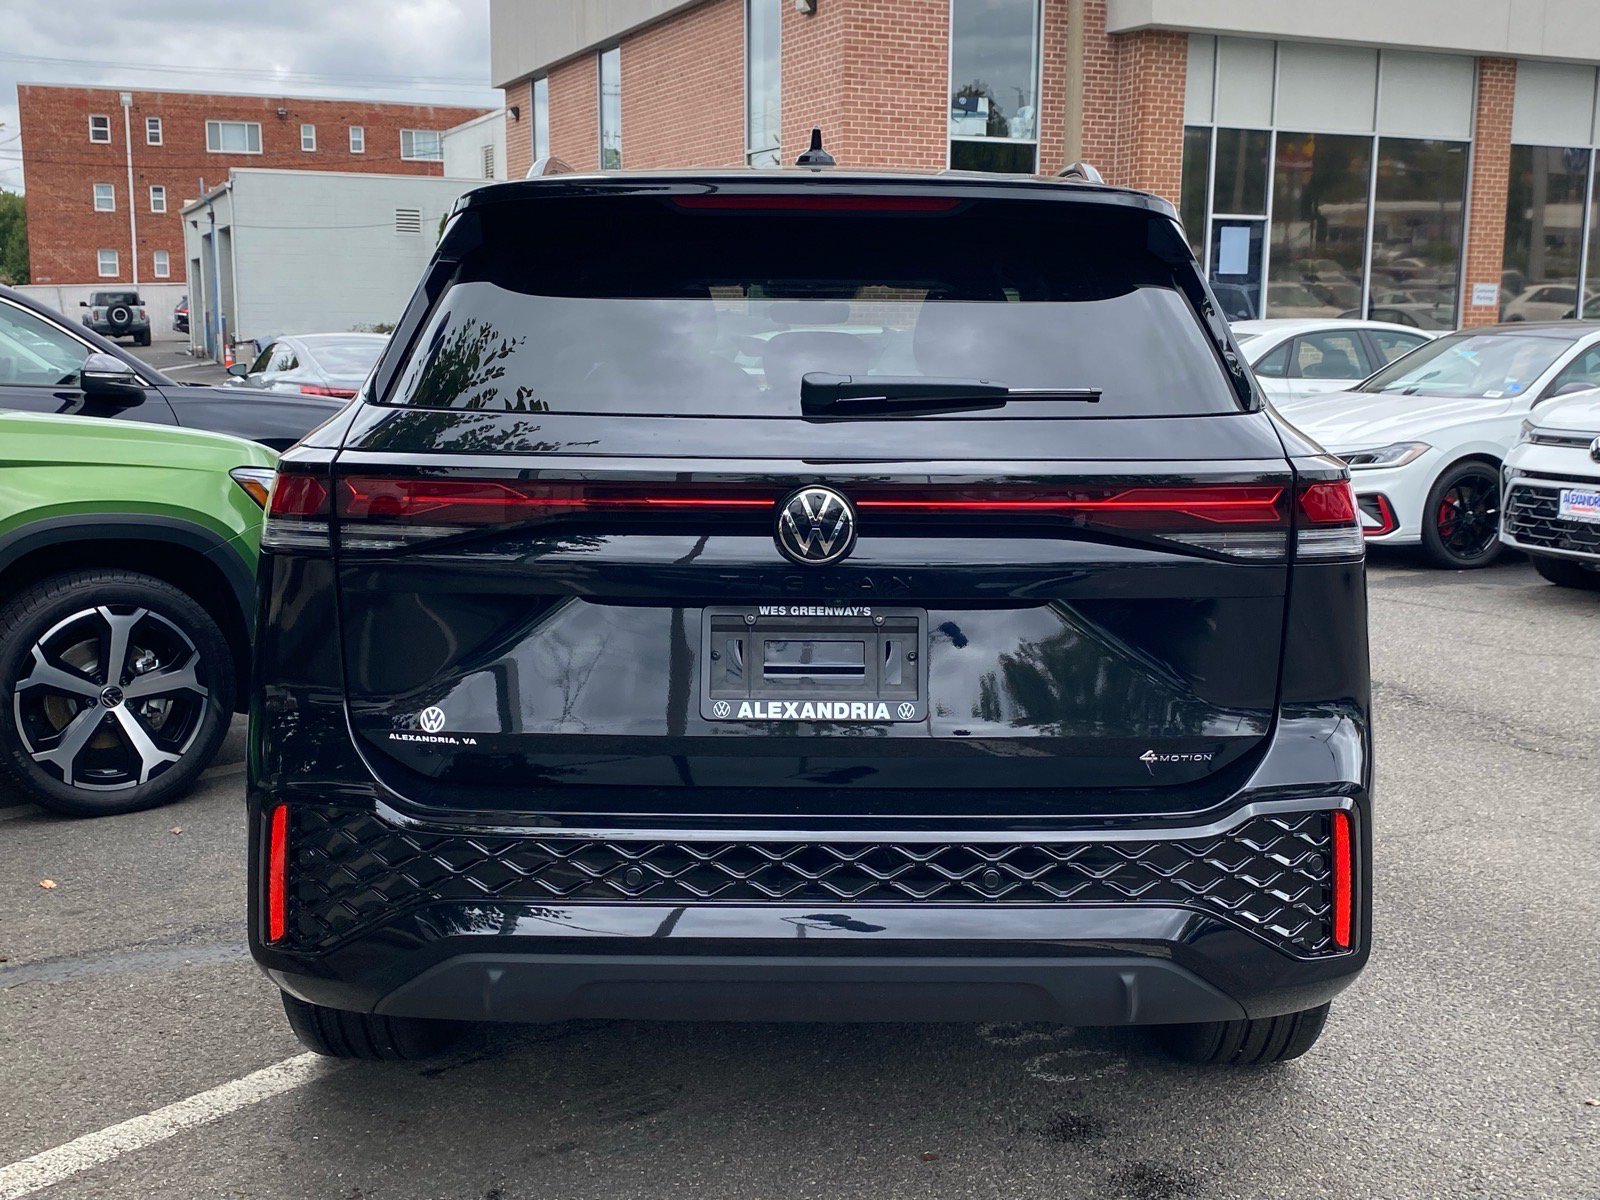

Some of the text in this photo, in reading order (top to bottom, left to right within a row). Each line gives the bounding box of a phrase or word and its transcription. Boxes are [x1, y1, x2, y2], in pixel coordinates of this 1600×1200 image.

[758, 606, 872, 617] WES GREENWAY'S
[737, 701, 891, 719] ALEXANDRIA
[389, 733, 477, 745] ALEXANDRIA, VA
